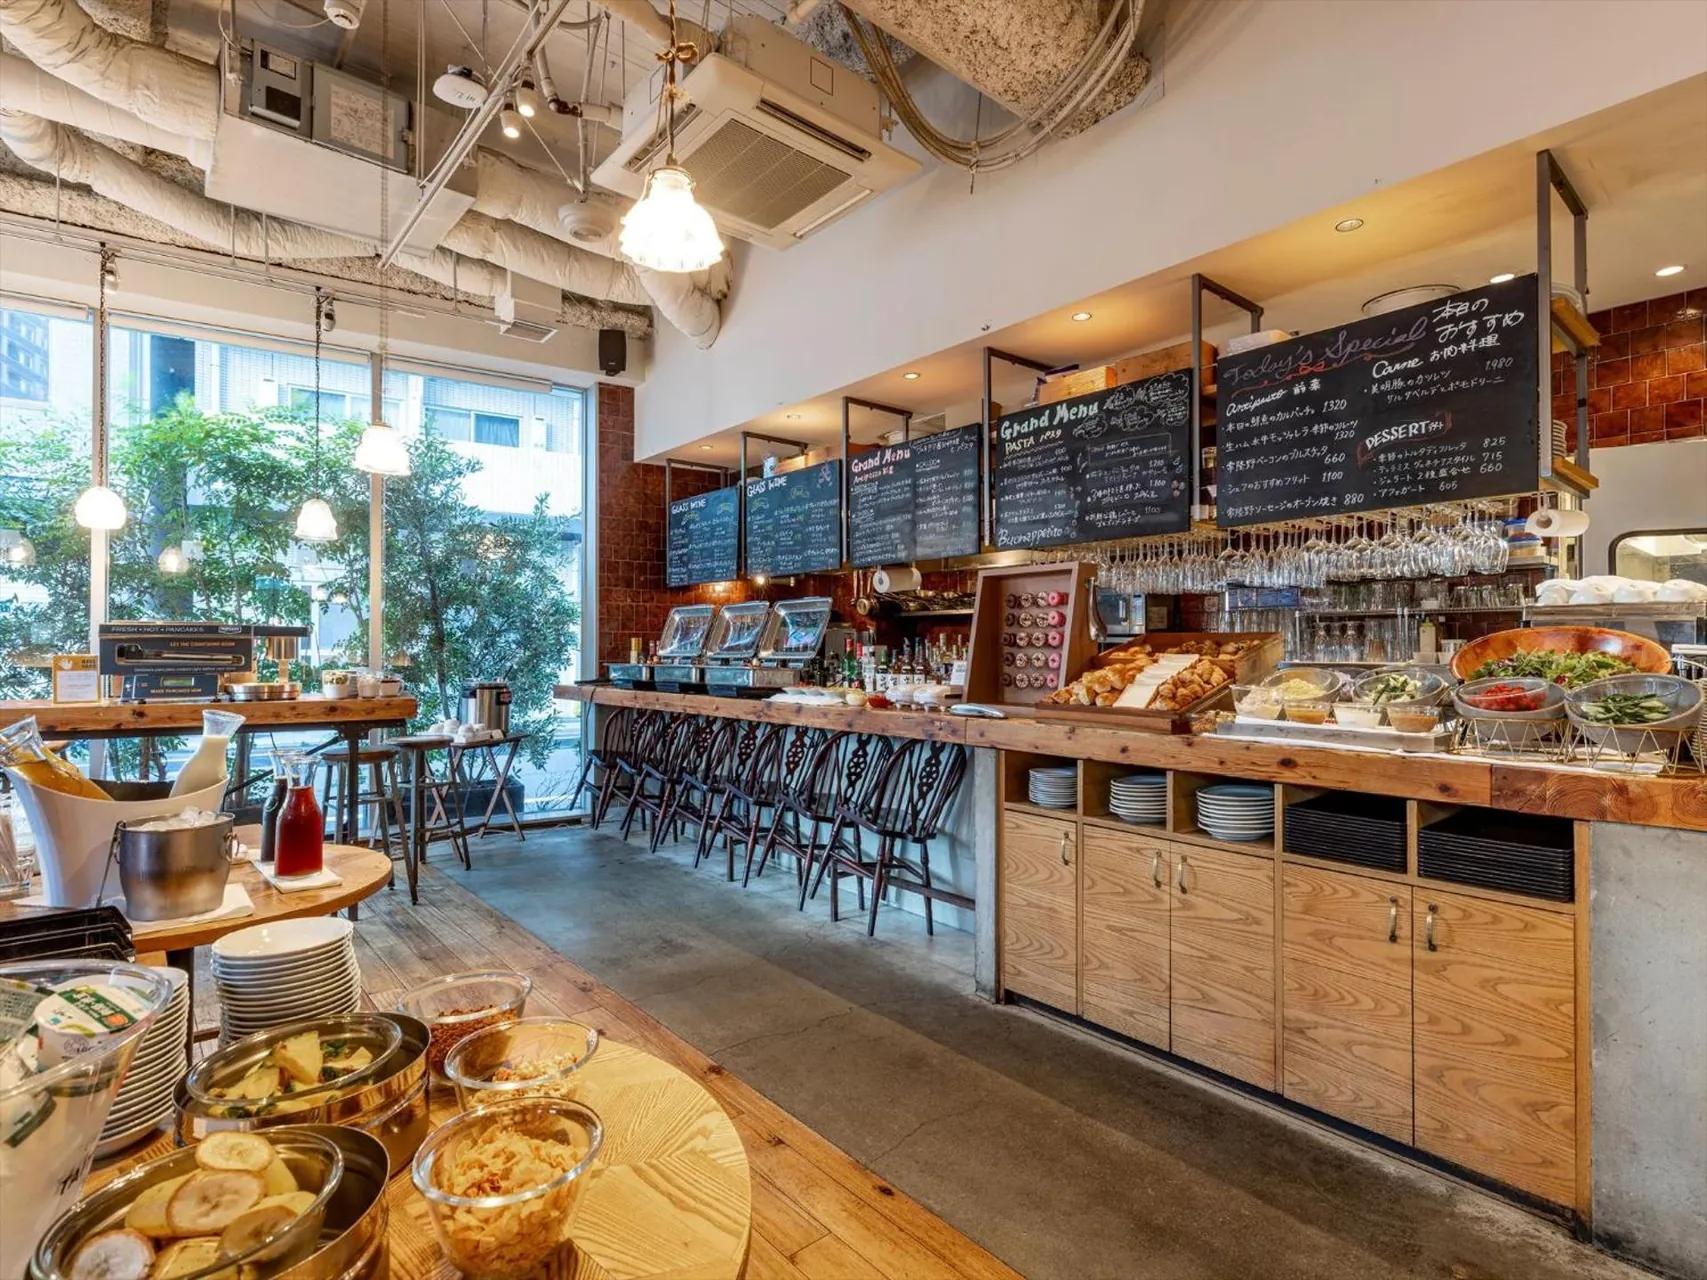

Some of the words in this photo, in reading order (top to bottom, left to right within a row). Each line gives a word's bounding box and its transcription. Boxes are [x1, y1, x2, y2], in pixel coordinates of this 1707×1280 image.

[1432, 298, 1489, 323] 本日の
[1436, 310, 1525, 343] おすすめ
[1223, 345, 1313, 386] Today's
[1325, 315, 1428, 366] Special
[1372, 357, 1424, 379] Carne
[1429, 334, 1501, 362] お肉料理
[1322, 399, 1347, 414] 1320
[1001, 409, 1050, 440] Grand
[1053, 401, 1099, 425] Menu
[1334, 430, 1356, 442] 1320
[1365, 420, 1430, 450] DESSERT
[1482, 436, 1507, 448] 825
[1005, 436, 1035, 455] PASTA
[852, 450, 880, 473] Grand
[882, 447, 911, 465] Menu
[1324, 453, 1347, 465] 660
[1483, 451, 1504, 462] 715
[1322, 471, 1344, 483] 1100
[1480, 462, 1503, 475] 660
[747, 480, 766, 496] GLASS
[768, 476, 788, 490] WINE
[1439, 480, 1458, 492] 605
[1343, 493, 1365, 506] 880
